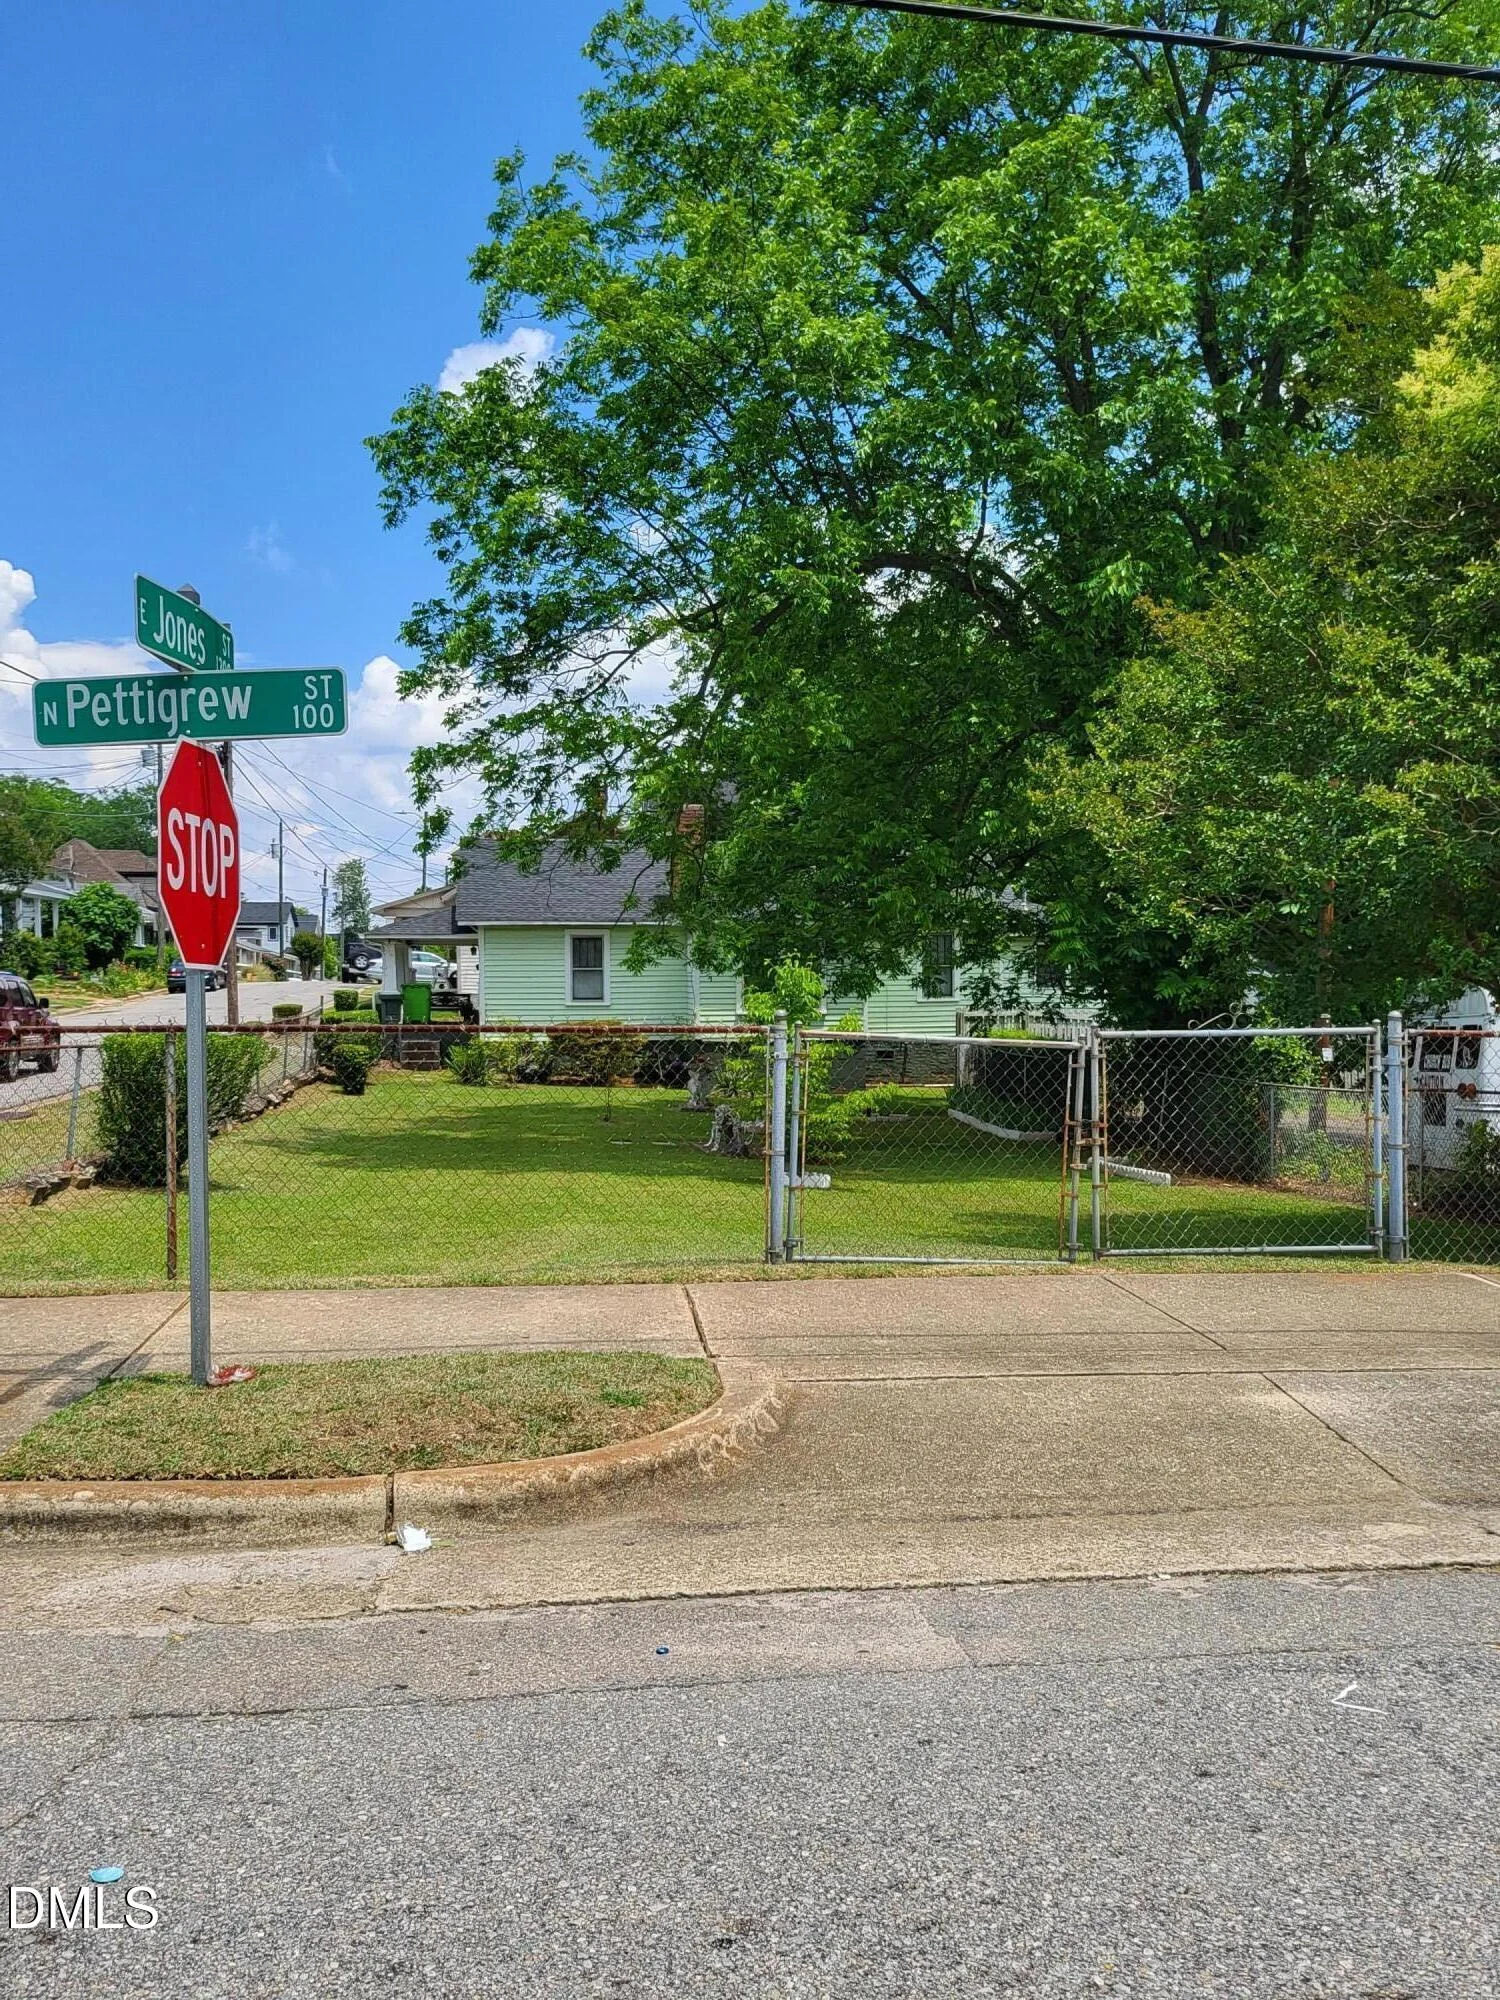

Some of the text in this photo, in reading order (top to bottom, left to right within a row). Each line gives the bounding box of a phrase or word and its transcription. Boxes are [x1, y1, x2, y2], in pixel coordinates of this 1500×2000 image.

[140, 595, 231, 665] E Jones ST
[43, 675, 333, 737] N Pettigrew ST
[293, 703, 335, 729] 100
[166, 807, 235, 899] STOP
